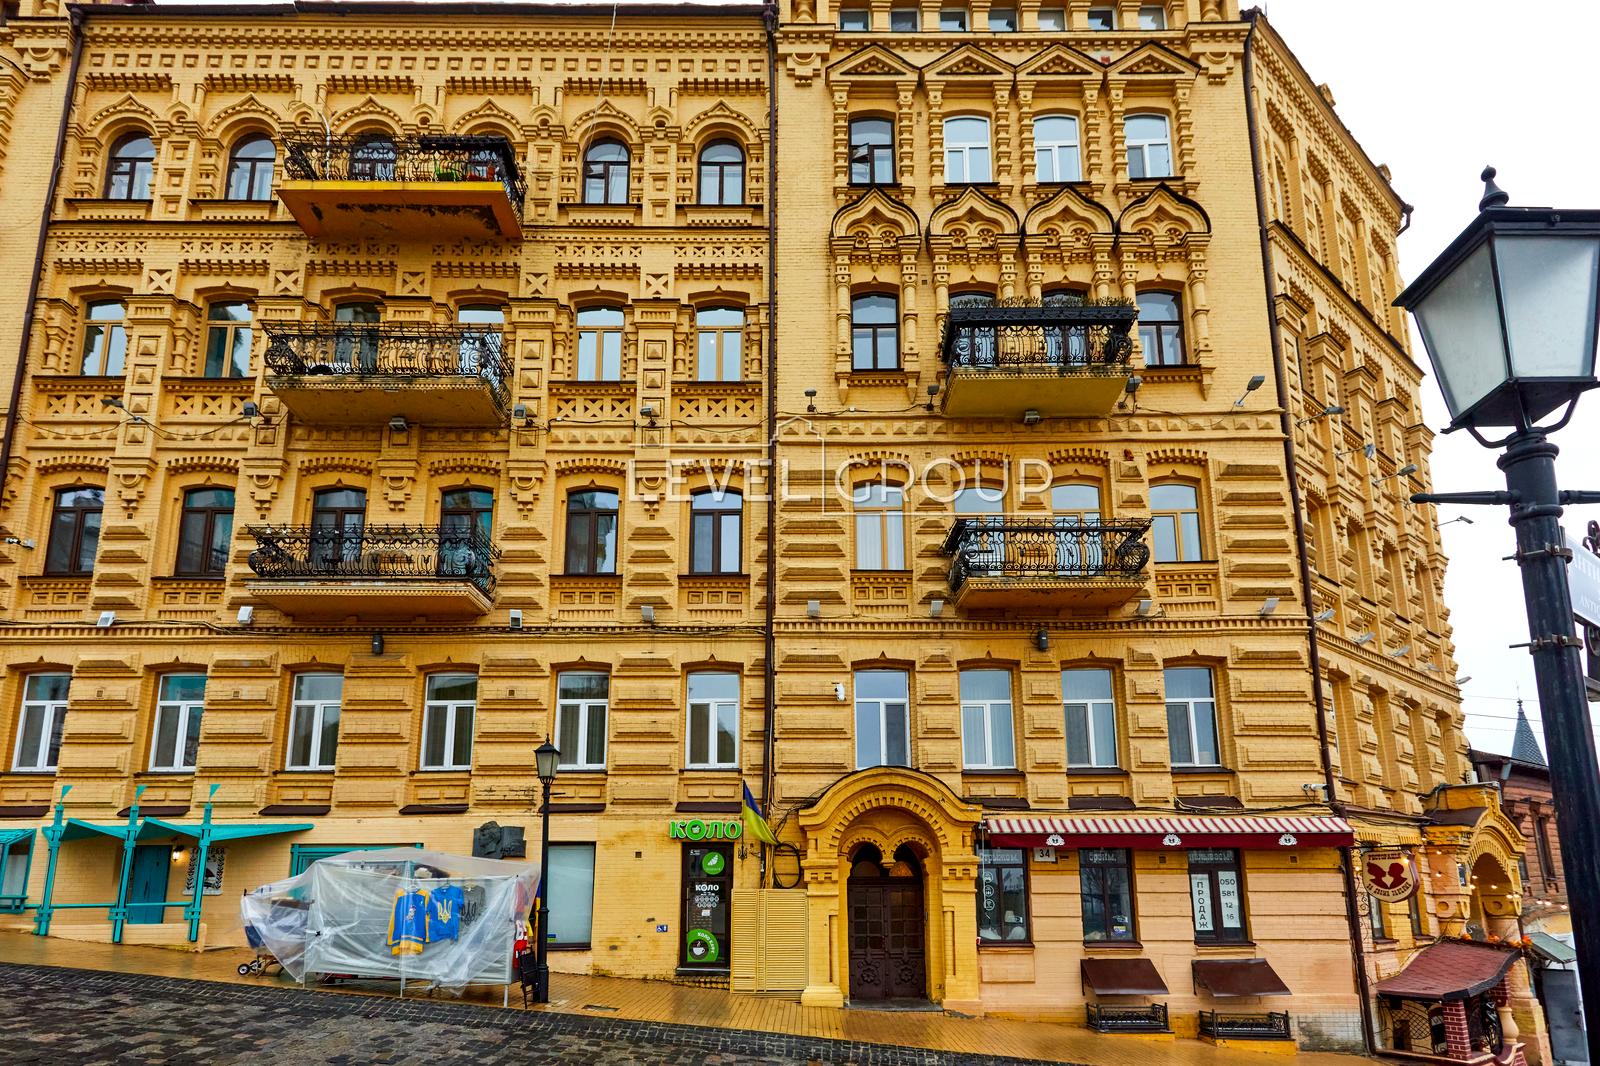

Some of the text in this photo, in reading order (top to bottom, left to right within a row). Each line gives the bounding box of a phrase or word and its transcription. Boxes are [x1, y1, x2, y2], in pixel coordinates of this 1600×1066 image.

[669, 819, 742, 841] КОЛО
[1039, 849, 1050, 858] 34
[1220, 878, 1236, 886] 050
[695, 883, 719, 892] КОЛО
[1196, 881, 1209, 929] ПРОДАЖ
